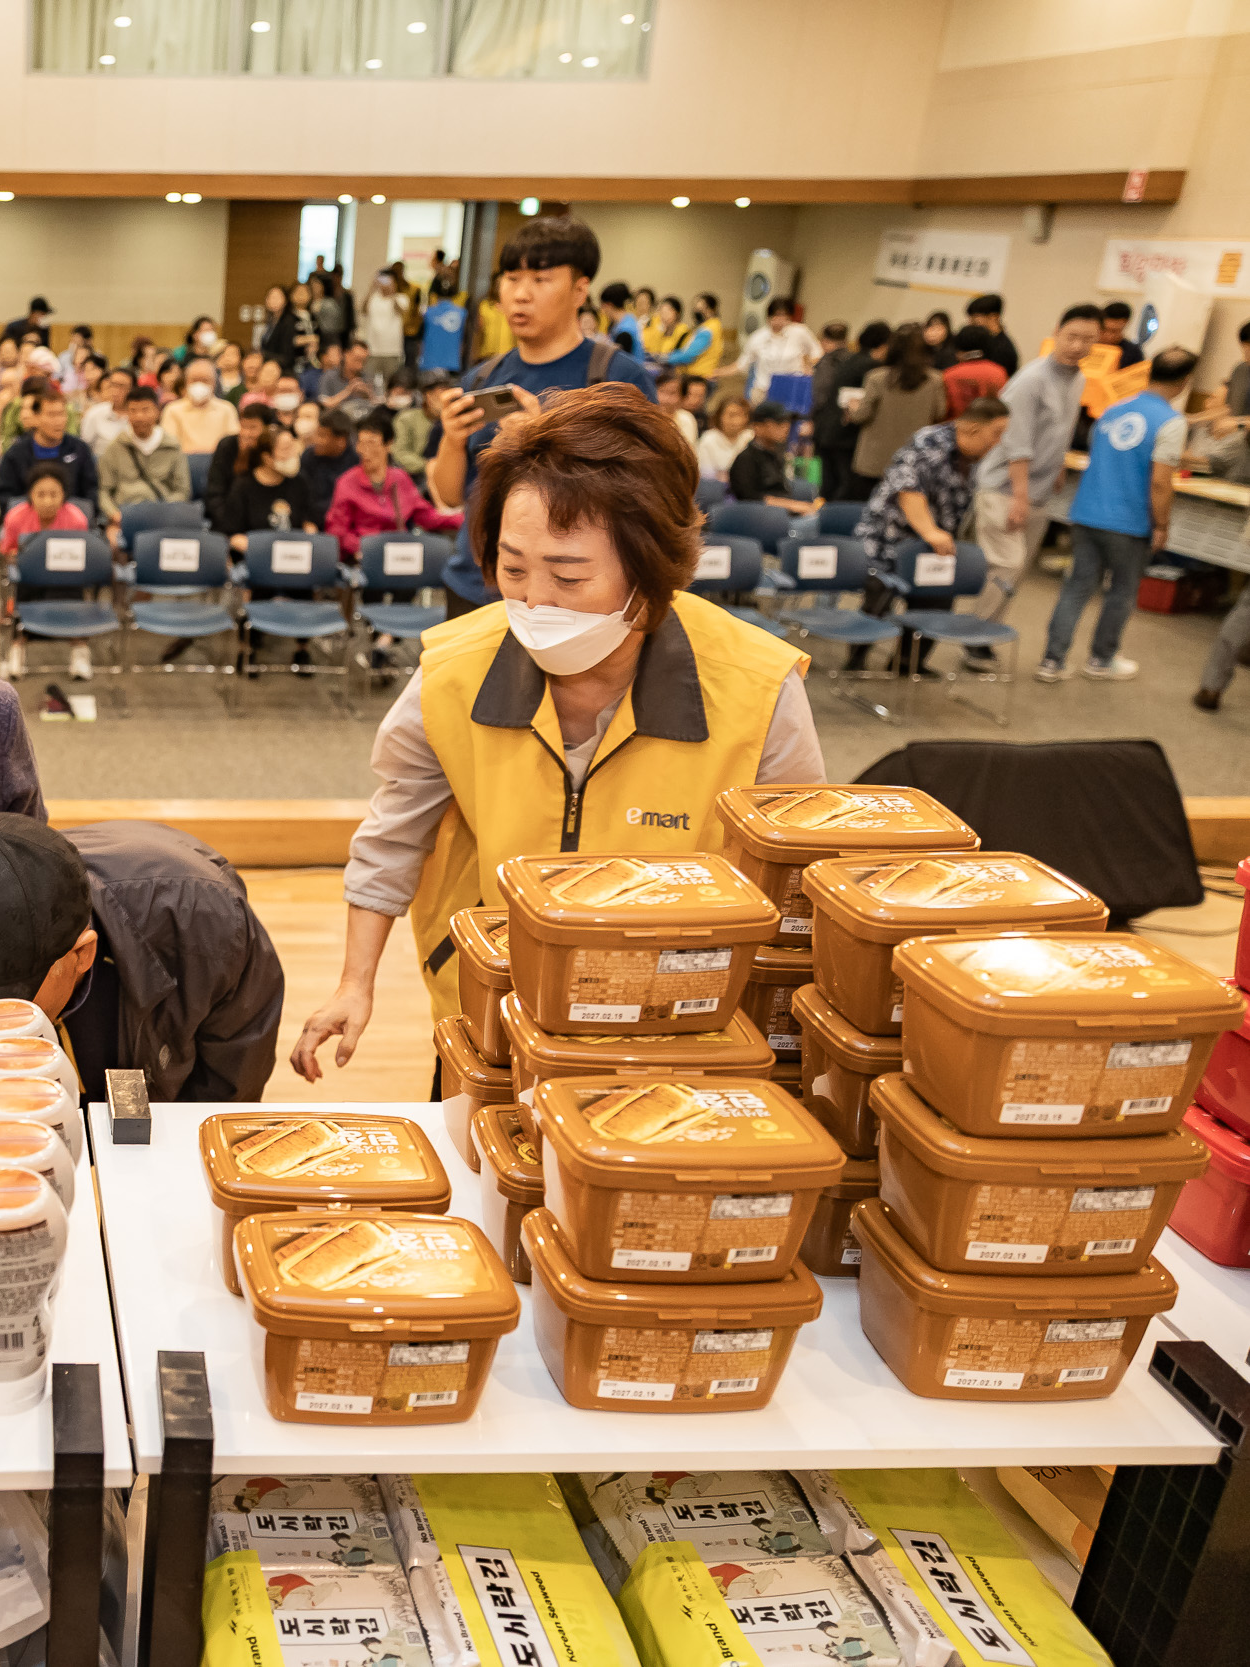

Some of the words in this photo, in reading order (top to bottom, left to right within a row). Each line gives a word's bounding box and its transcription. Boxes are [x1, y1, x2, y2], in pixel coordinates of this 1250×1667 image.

[626, 807, 690, 831] emart
[581, 1012, 623, 1021] 2027.02.19
[337, 1130, 399, 1146] 된장
[979, 1251, 1027, 1260] 2027.02.19
[611, 1389, 656, 1398] 2027.02.19
[957, 1378, 1003, 1387] 2027.02.19
[255, 1514, 350, 1532] 도시락김
[410, 1508, 425, 1532] Brand
[672, 1500, 768, 1522] 도시락김
[419, 1531, 430, 1544] No
[639, 1519, 656, 1543] Brand
[965, 1555, 1005, 1608] Seaweed
[530, 1571, 559, 1620] Seaweed
[910, 1539, 1011, 1652] 도시락김
[475, 1556, 543, 1667] 도시락김
[730, 1600, 834, 1626] 도시락김
[279, 1617, 380, 1637] 도시락김
[453, 1612, 470, 1640] Brand
[1002, 1608, 1039, 1649] Korean
[464, 1639, 474, 1652] No
[554, 1621, 578, 1663] Korean
[705, 1622, 734, 1660] Brand
